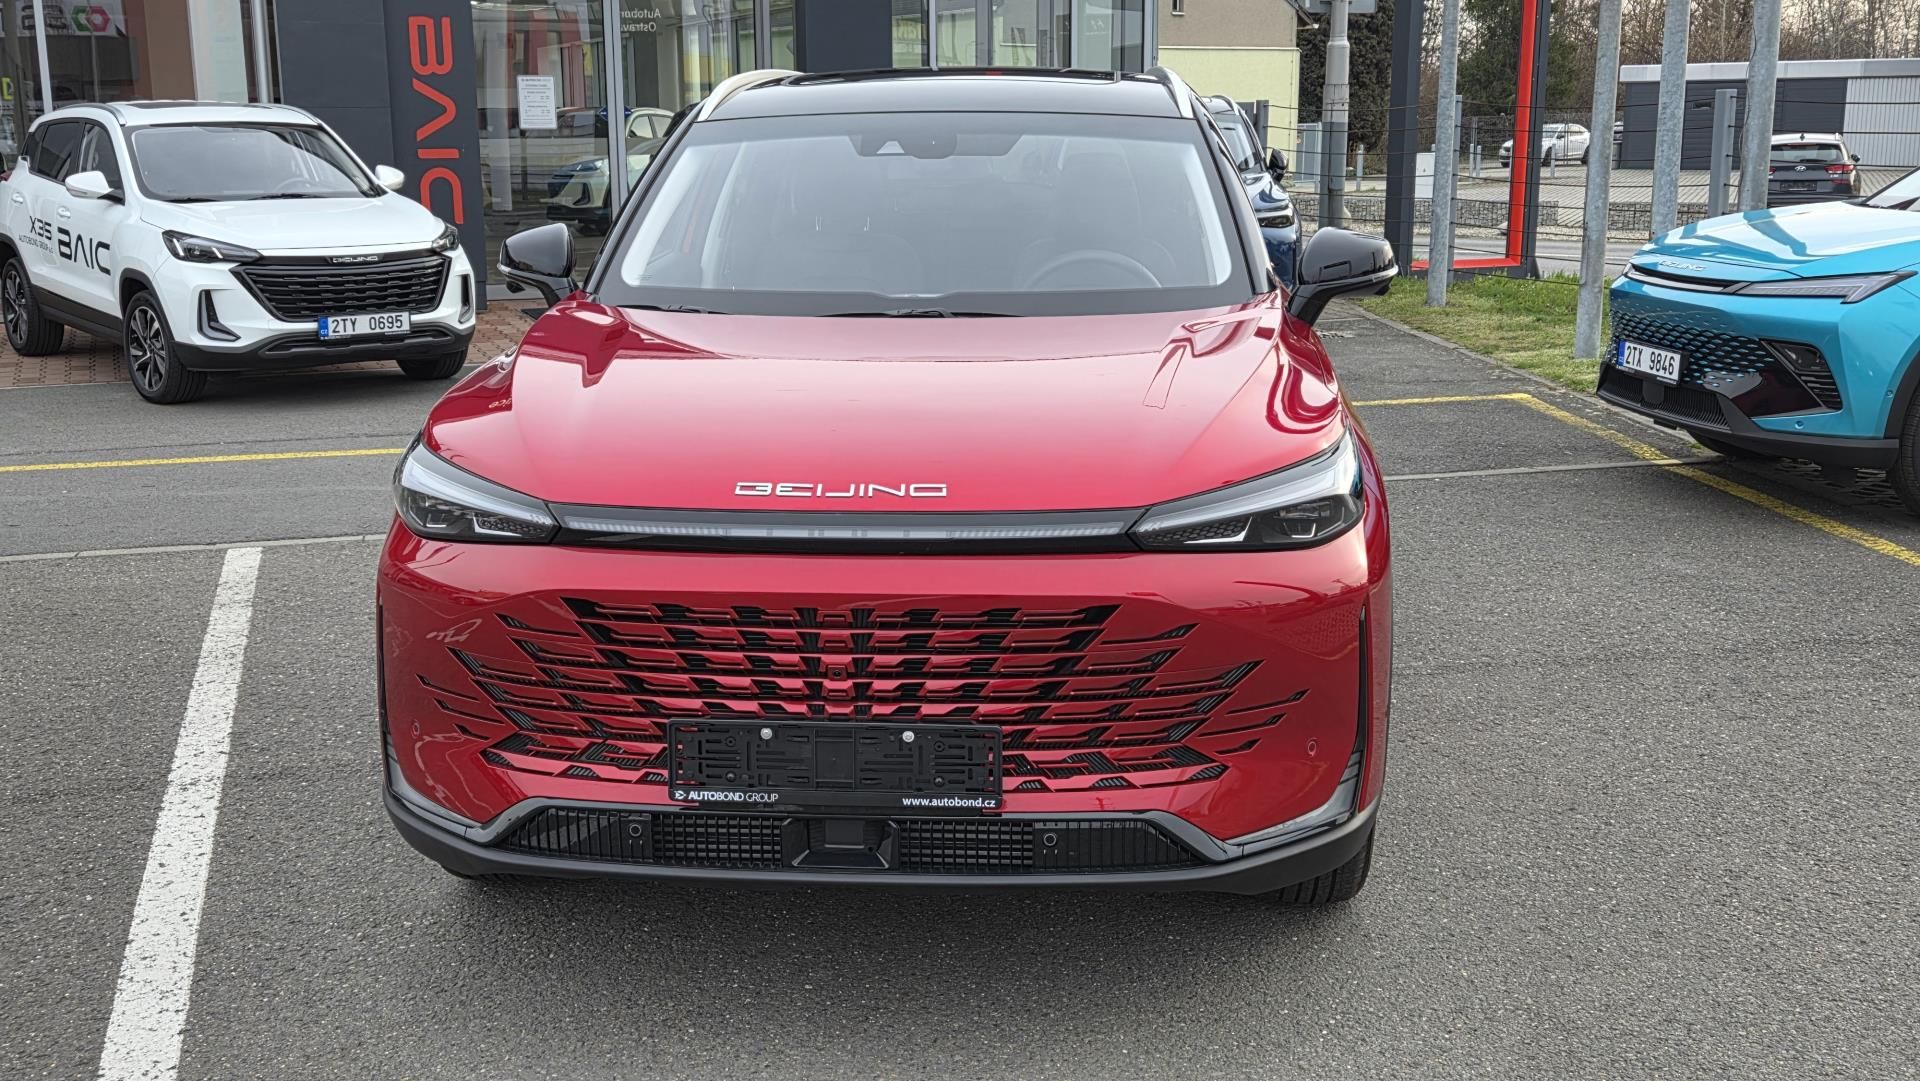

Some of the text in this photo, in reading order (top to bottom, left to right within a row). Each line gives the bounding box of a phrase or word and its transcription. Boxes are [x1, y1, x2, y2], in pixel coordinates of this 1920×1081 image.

[408, 16, 464, 225] BAIC
[57, 226, 111, 276] BAIC
[331, 314, 403, 334] 2TY 0695
[1625, 345, 1676, 376] 2TX 9846
[735, 482, 948, 498] BEIJING
[688, 790, 779, 803] AUTOBOND GROUP
[902, 797, 996, 808] www.autobond.cz
